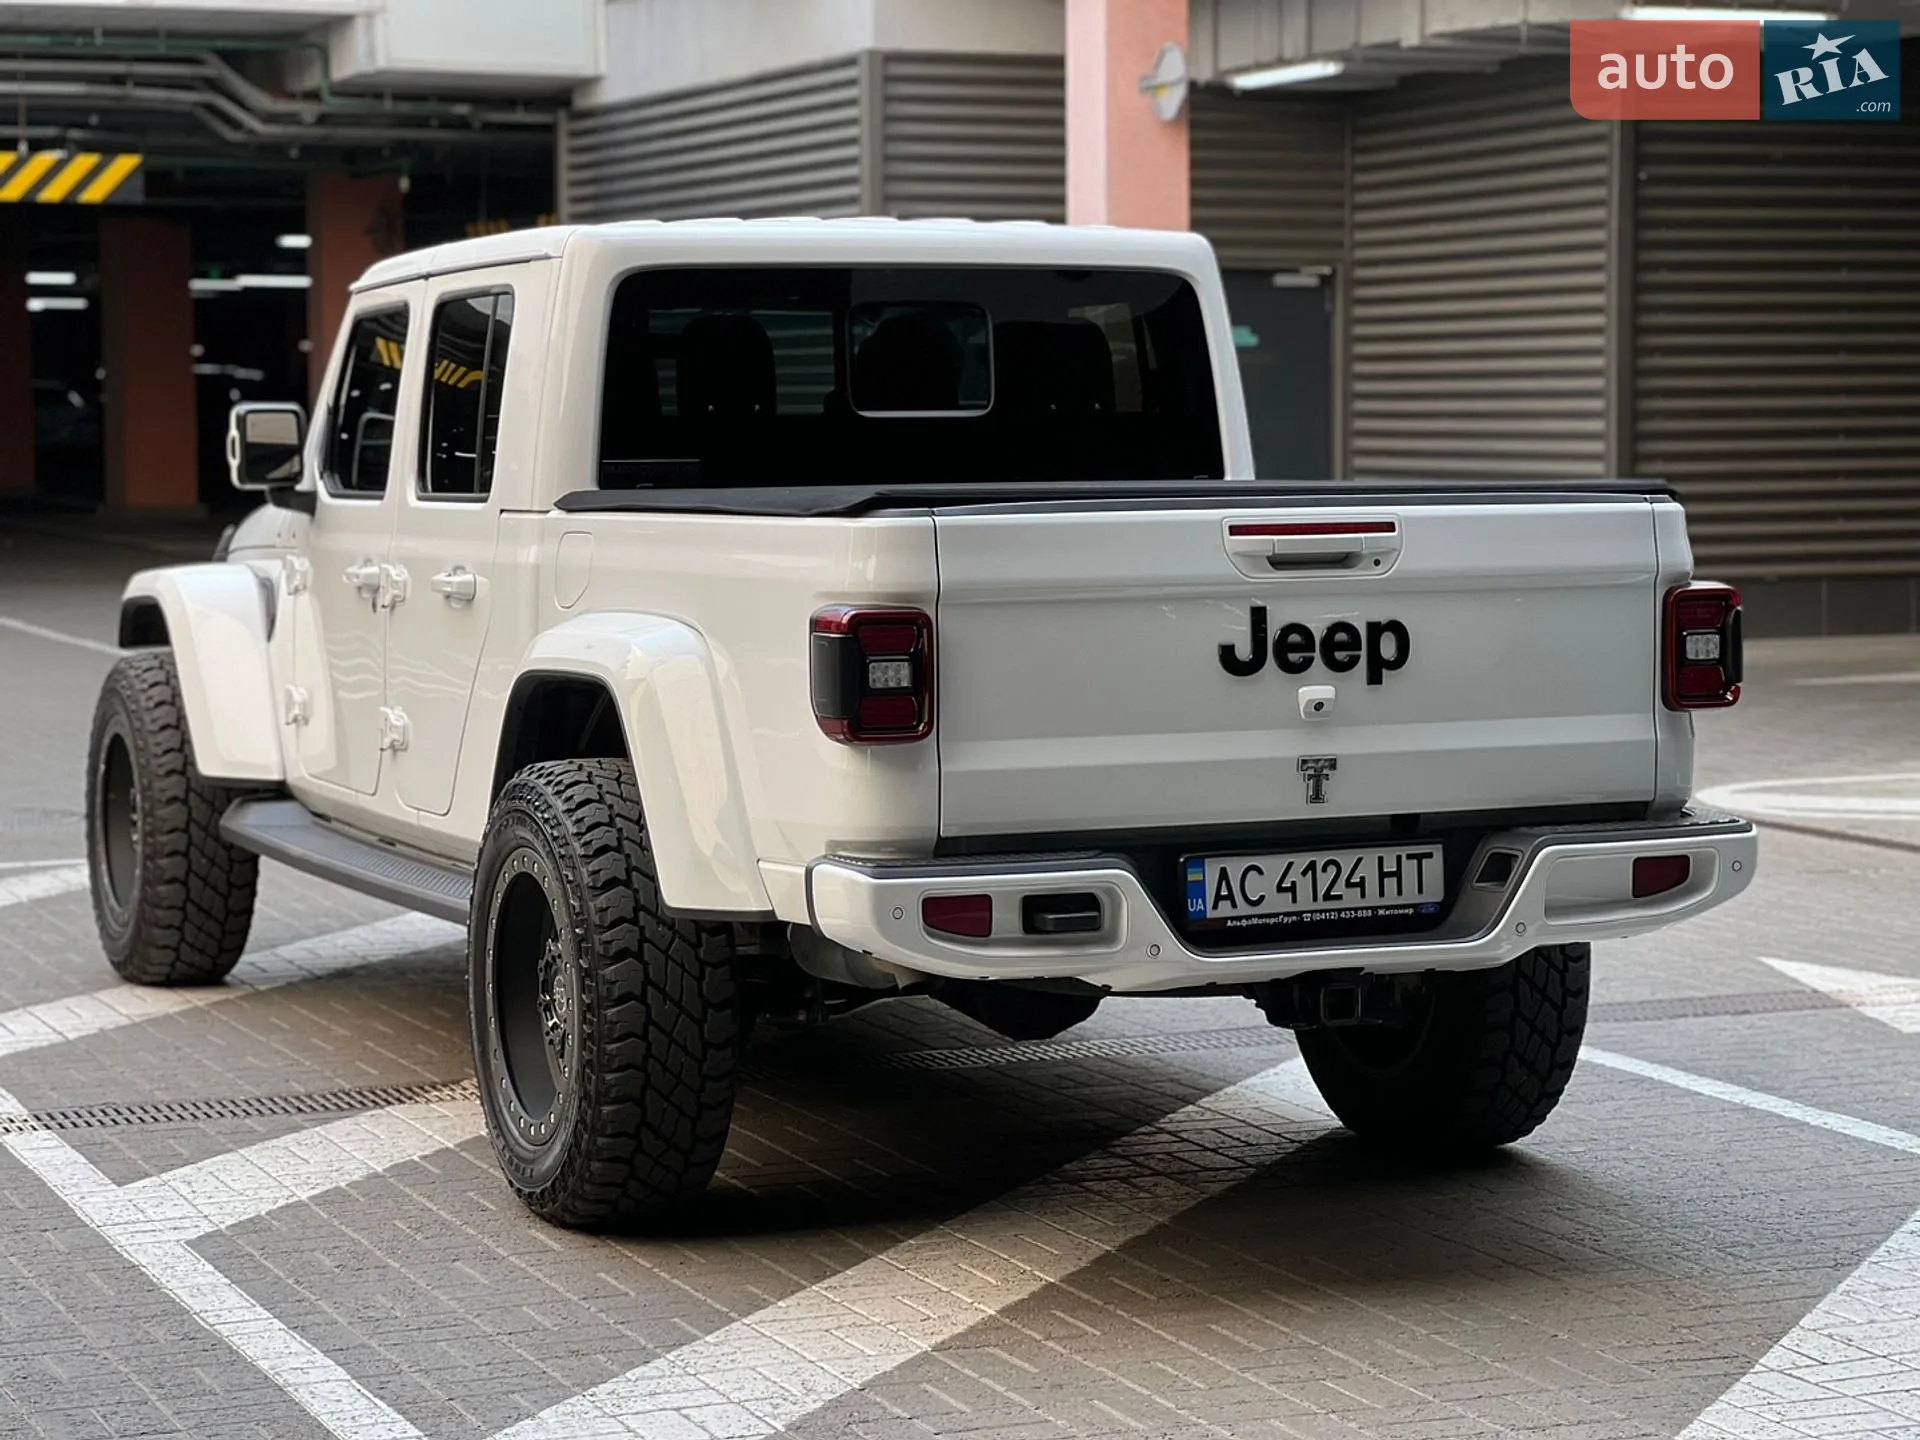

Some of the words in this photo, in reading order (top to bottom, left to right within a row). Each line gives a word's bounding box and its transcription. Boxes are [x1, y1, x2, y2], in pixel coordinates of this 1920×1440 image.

[1218, 605, 1411, 686] Jeep
[1187, 898, 1205, 912] UA
[1212, 864, 1265, 910] AC
[1276, 856, 1366, 904] 4124
[1378, 851, 1433, 898] HT
